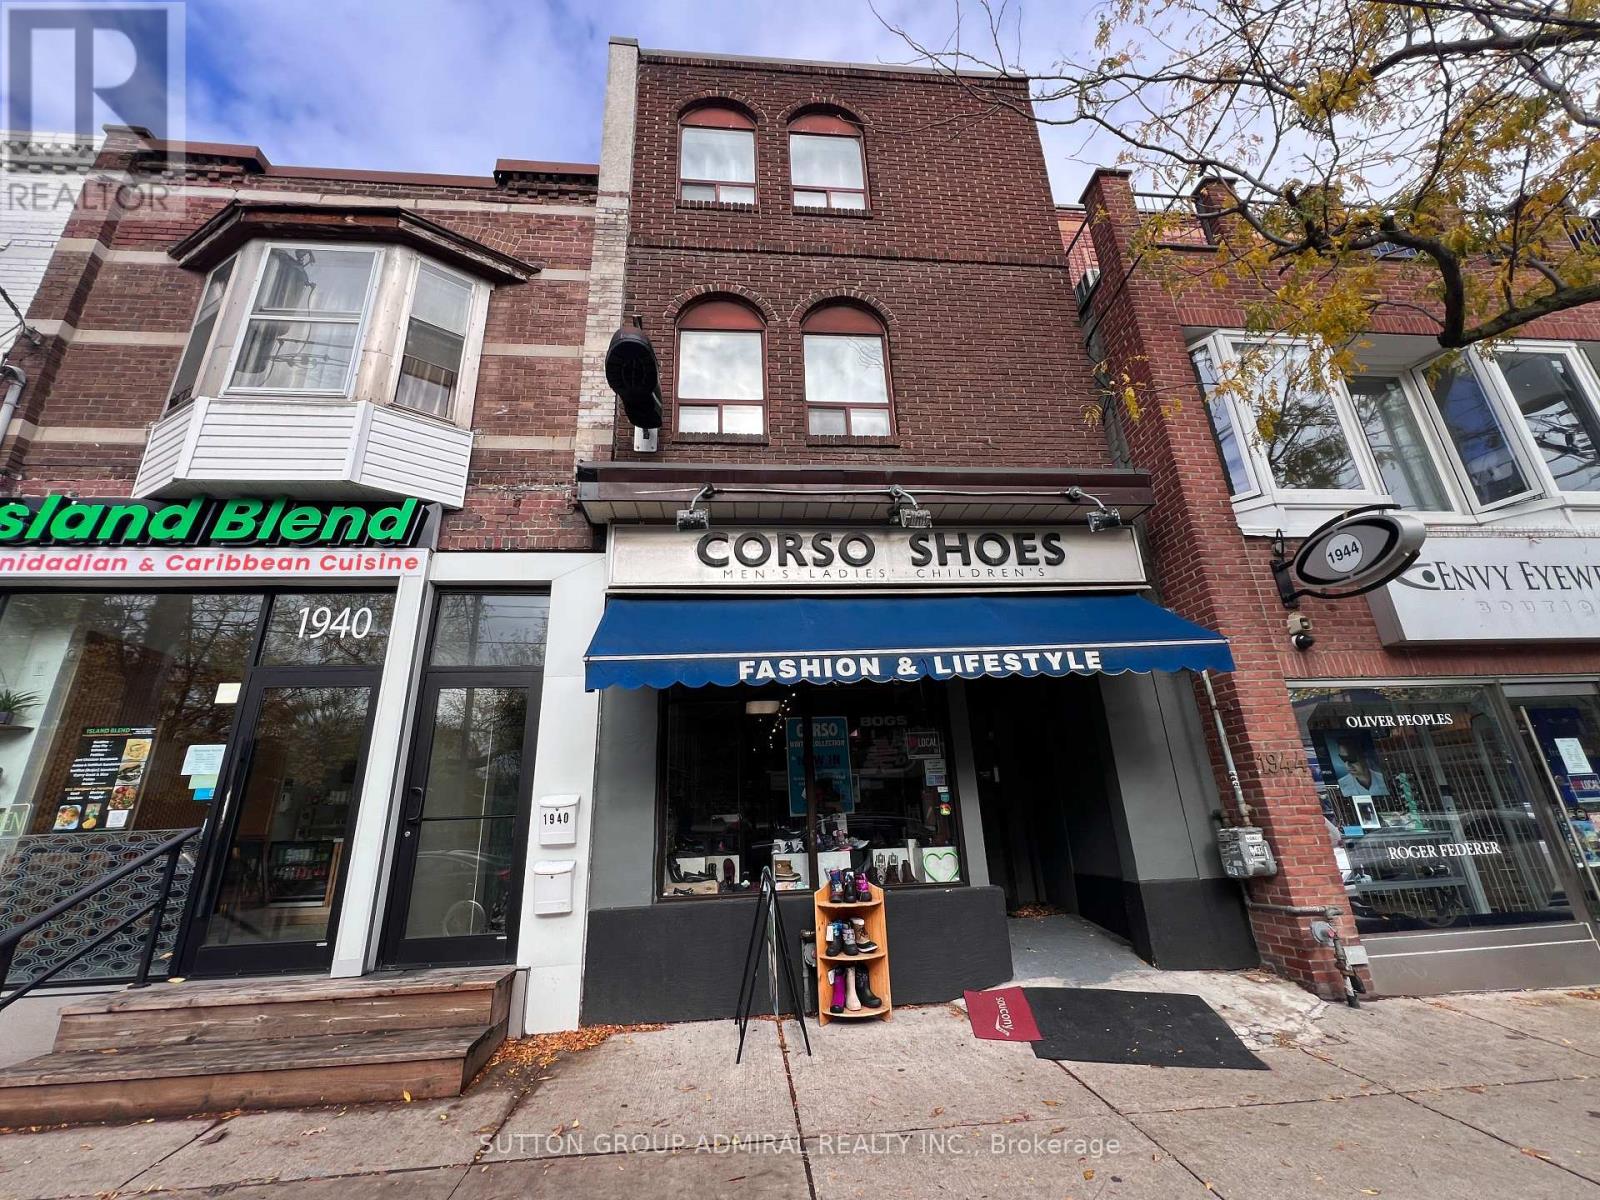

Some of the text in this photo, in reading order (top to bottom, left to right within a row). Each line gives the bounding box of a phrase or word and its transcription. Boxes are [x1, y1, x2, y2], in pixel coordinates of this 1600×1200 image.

[210, 497, 417, 540] Blend
[697, 531, 1066, 567] CORSO SHOES
[1328, 541, 1359, 563] 1944
[138, 557, 154, 571] &
[166, 553, 310, 571] Caribbean
[320, 553, 418, 571] Cuisine
[916, 568, 1045, 579] CHILDREN'S
[1435, 561, 1513, 590] ENVY
[298, 607, 372, 639] 1940
[739, 651, 1102, 680] FASHION & LIFESTYLE
[796, 722, 838, 737] CRSO
[1346, 713, 1454, 728] OLIVER PEOPLES
[1256, 751, 1307, 775] 1944
[543, 812, 569, 825] 1940
[1387, 841, 1503, 860] ROGER FEDERER
[995, 996, 1015, 1031] saucony
